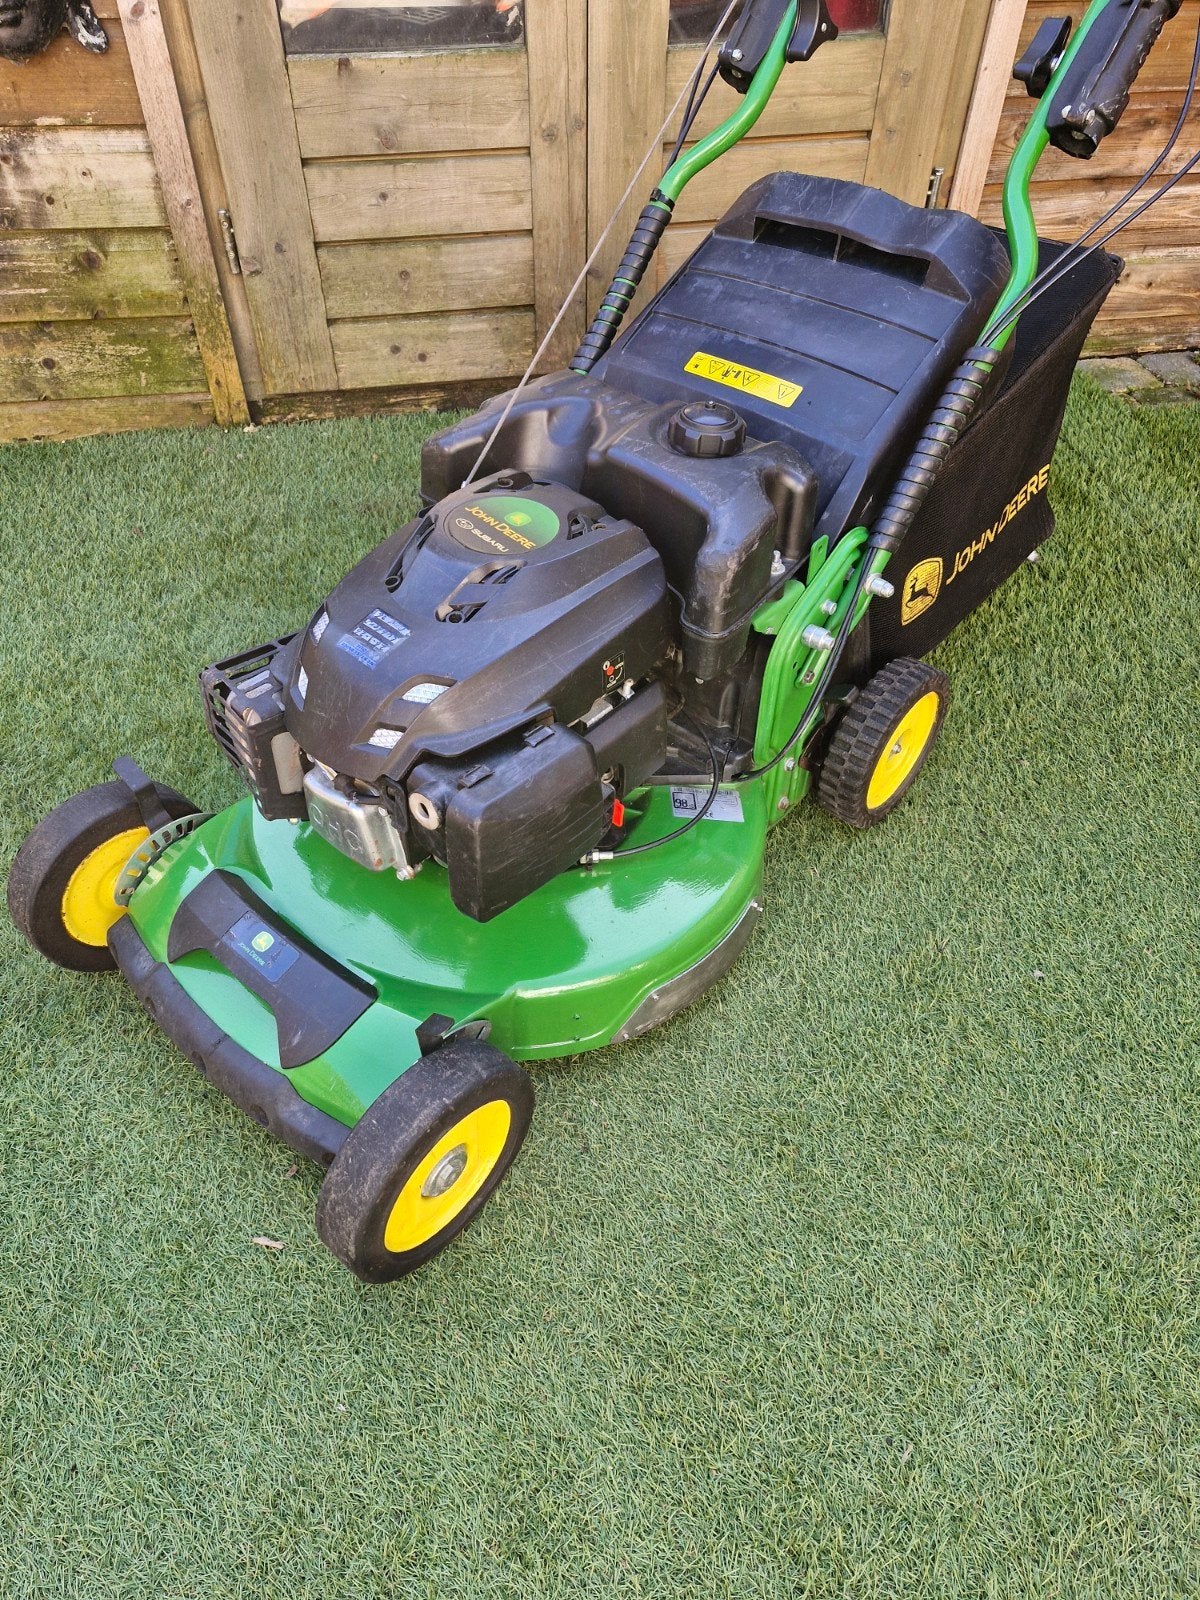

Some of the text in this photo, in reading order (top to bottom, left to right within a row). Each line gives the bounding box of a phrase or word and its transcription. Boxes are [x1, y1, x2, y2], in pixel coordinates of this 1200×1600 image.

[464, 506, 536, 550] JOHN DEERE
[946, 463, 1050, 585] JOHN DEERE
[470, 527, 509, 553] SUBARU
[674, 798, 688, 808] 98
[237, 942, 266, 967] JOHN DEERE
